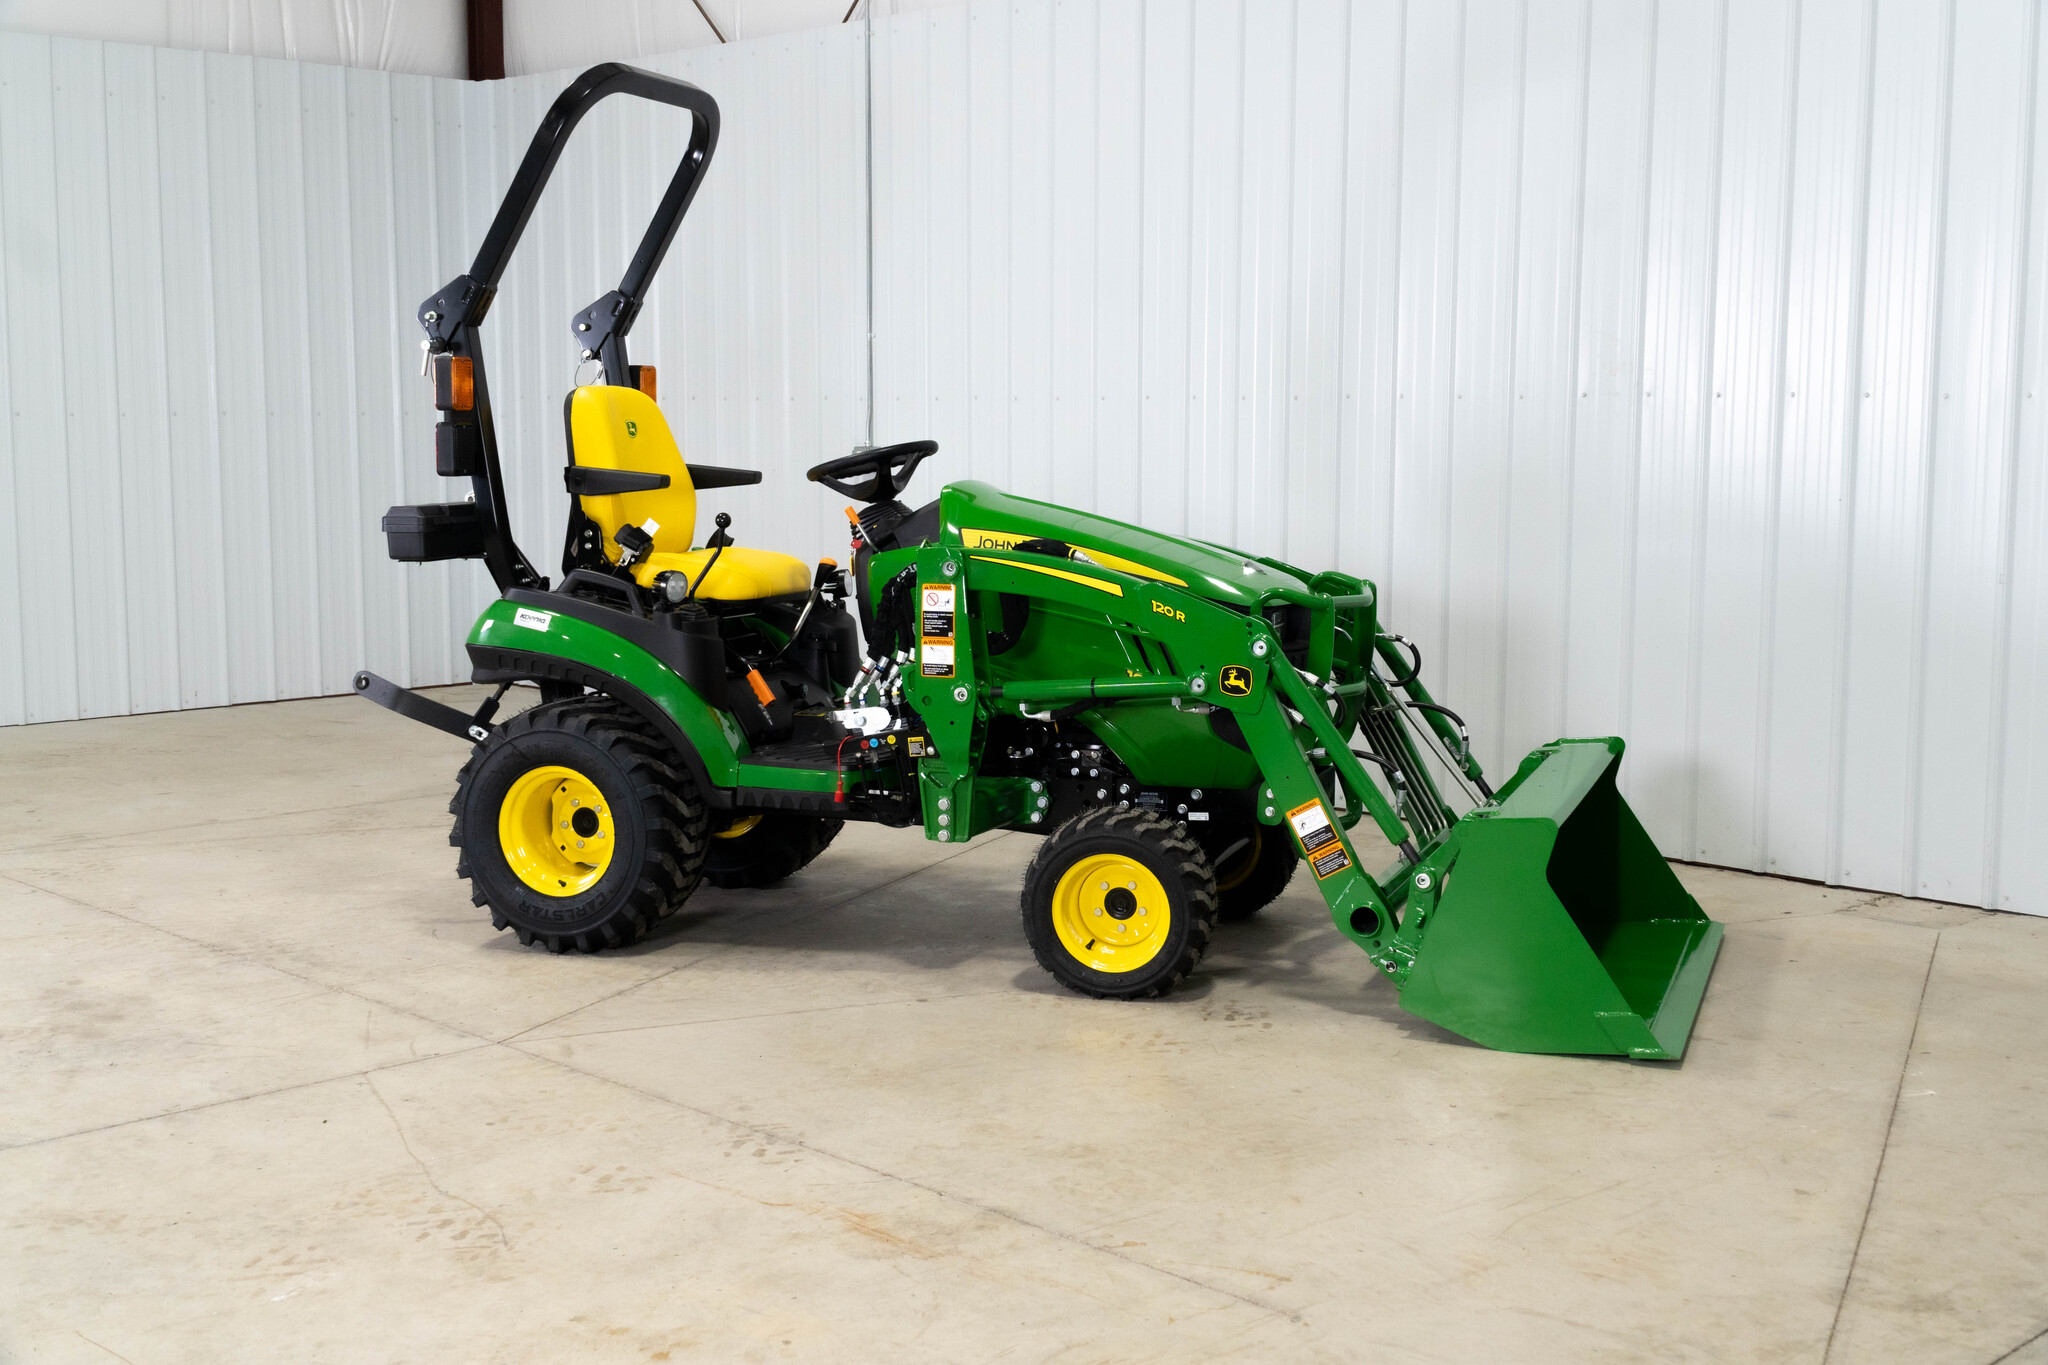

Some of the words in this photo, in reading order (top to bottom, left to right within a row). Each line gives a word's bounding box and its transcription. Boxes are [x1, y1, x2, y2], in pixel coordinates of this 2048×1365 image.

[973, 536, 1017, 550] JOHN
[1151, 599, 1174, 617] 120
[1175, 610, 1186, 624] R
[1295, 801, 1317, 814] WARNING
[1318, 844, 1340, 857] WARNING
[519, 892, 607, 920] CARLSTAR
